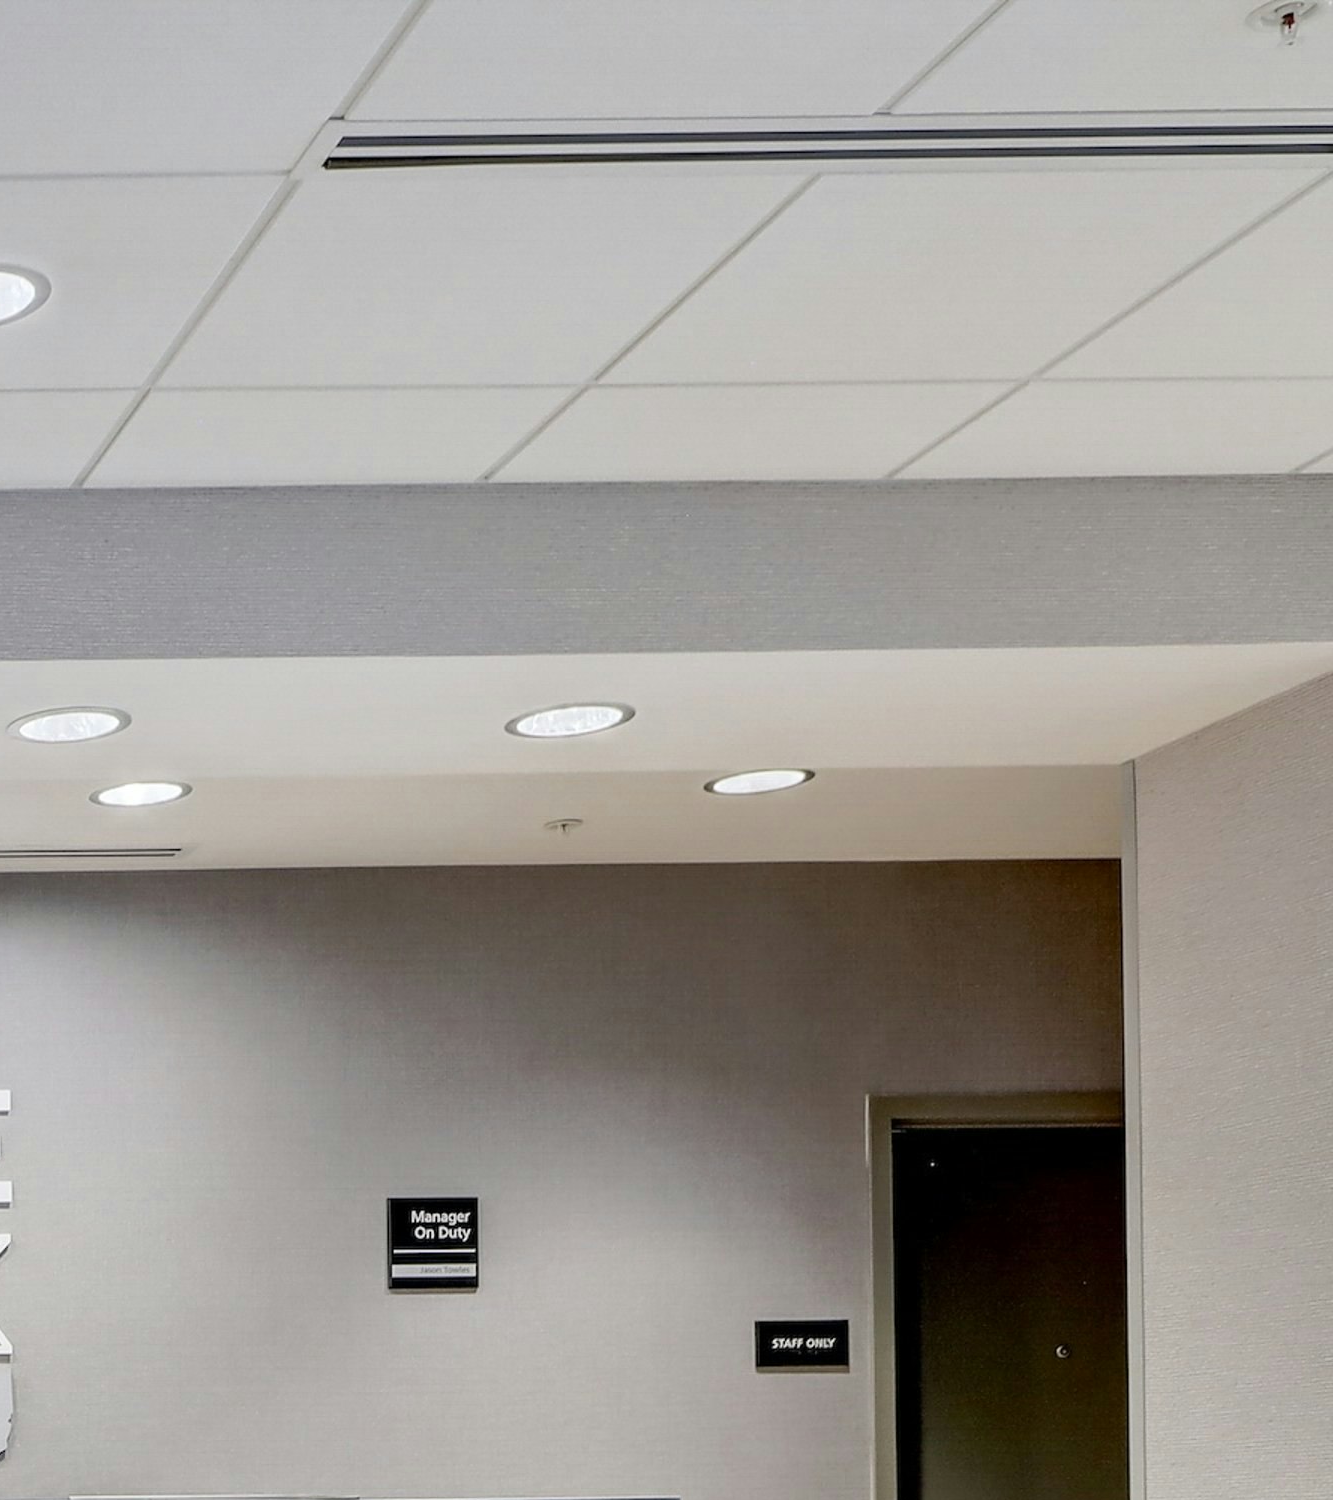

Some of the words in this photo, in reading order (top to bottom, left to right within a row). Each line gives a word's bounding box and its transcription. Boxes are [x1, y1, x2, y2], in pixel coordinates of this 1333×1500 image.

[411, 1210, 471, 1226] Manager
[414, 1226, 435, 1240] On
[438, 1226, 472, 1242] Duty
[771, 1337, 804, 1349] STAFF
[806, 1337, 836, 1349] ONLY
